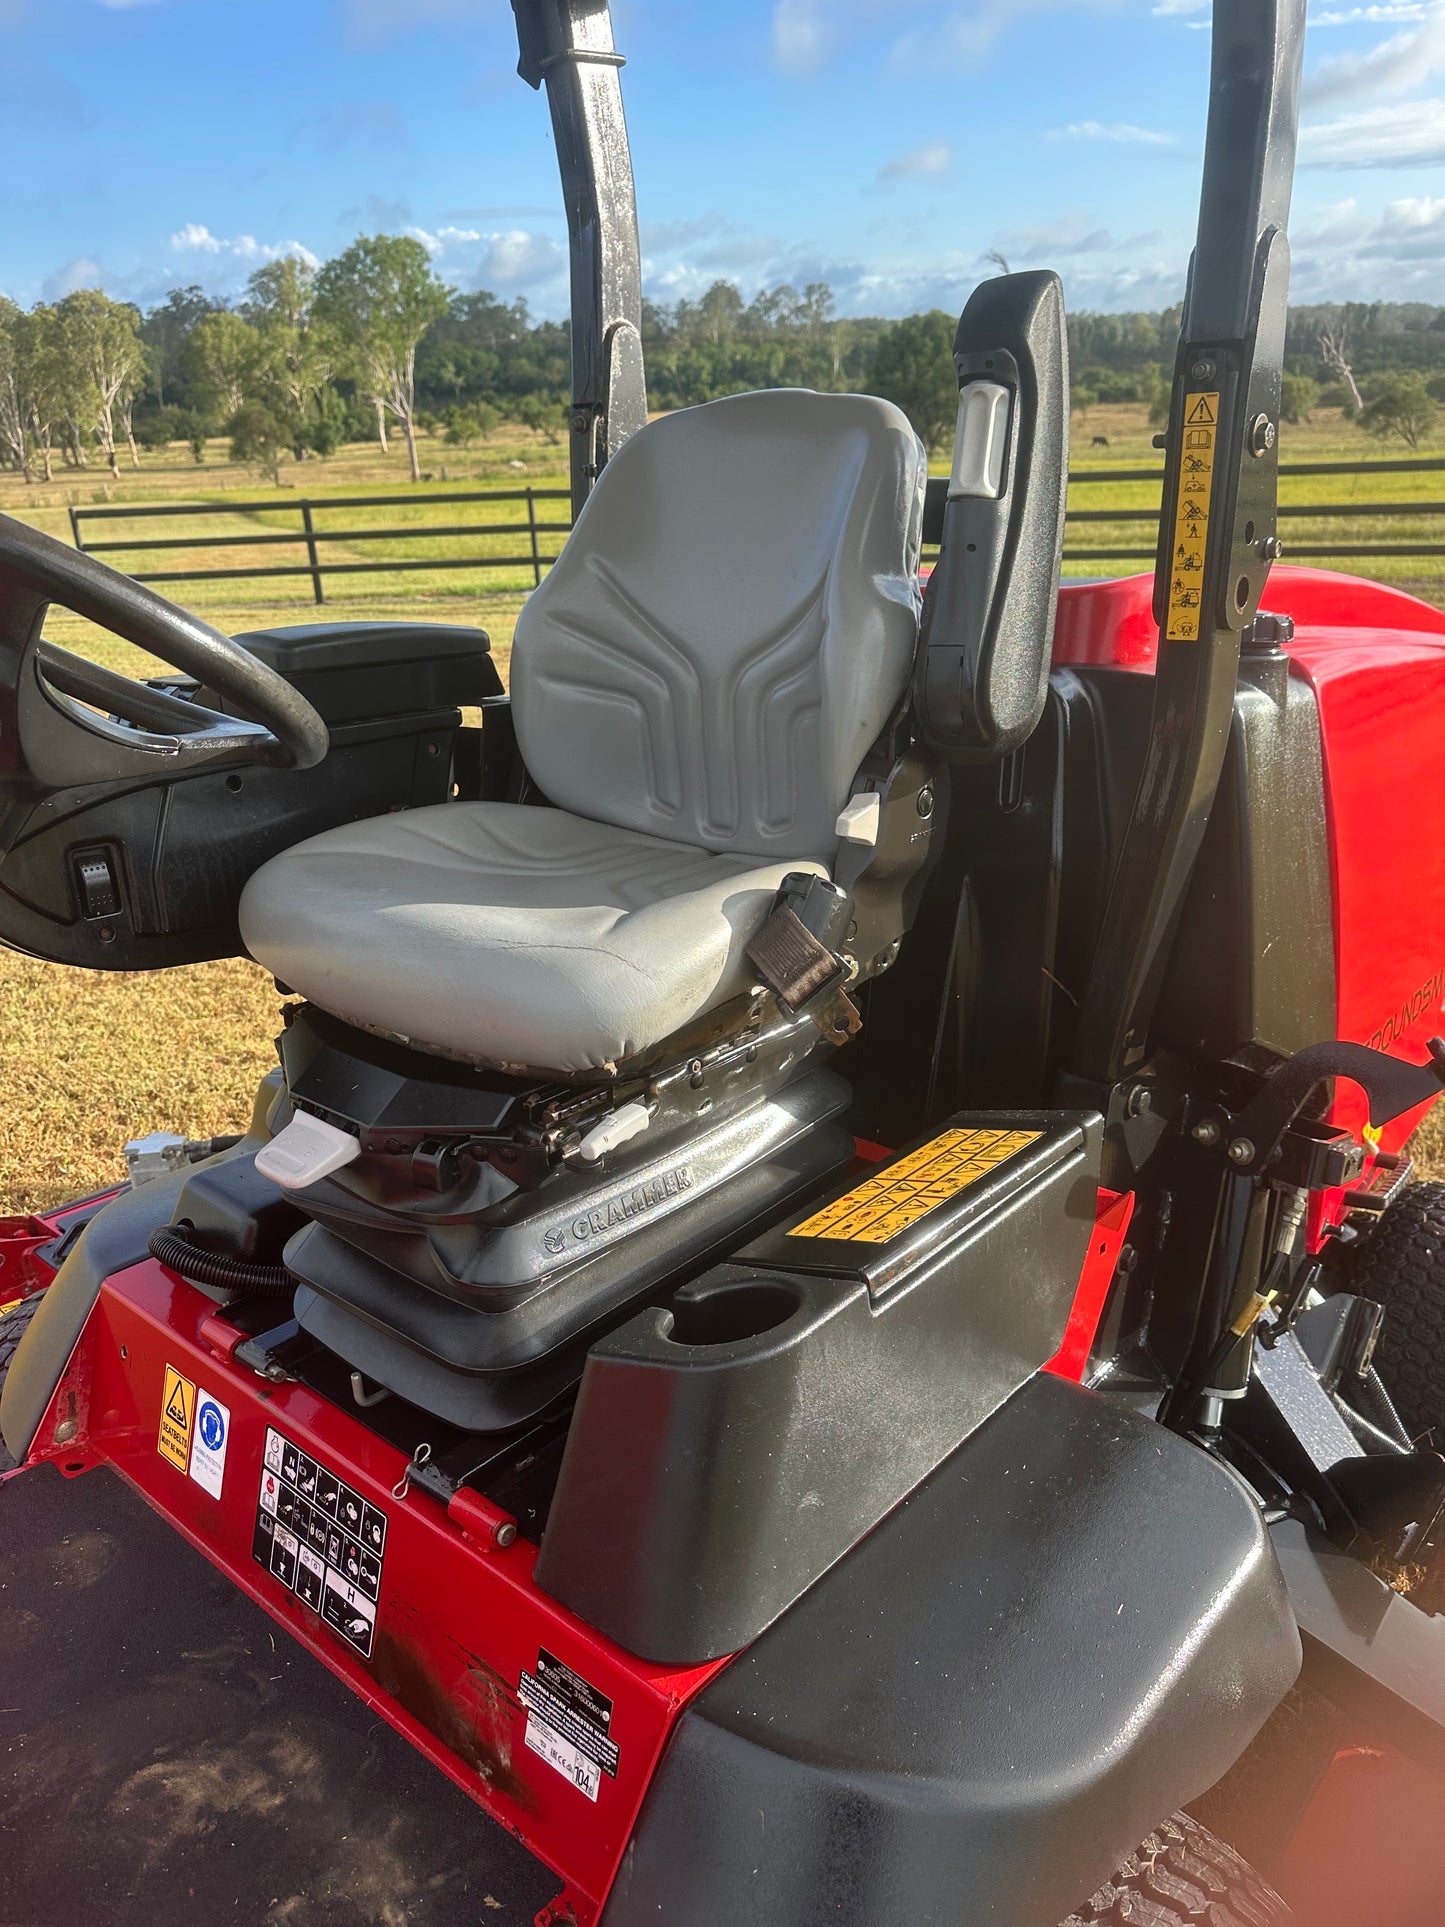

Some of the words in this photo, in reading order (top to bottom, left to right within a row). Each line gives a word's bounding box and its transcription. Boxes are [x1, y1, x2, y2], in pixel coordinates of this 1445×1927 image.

[1366, 969, 1444, 1052] ROUNDSM
[572, 1166, 692, 1240] GRAMMER
[163, 1421, 188, 1448] SEATBELTS
[170, 1442, 176, 1452] BE
[347, 1587, 356, 1603] H
[521, 1670, 549, 1697] CALIFORNIA
[549, 1692, 566, 1711] SPARK
[566, 1706, 593, 1732] ARRESTER
[593, 1727, 618, 1752] WARNING
[575, 1766, 589, 1792] 104
